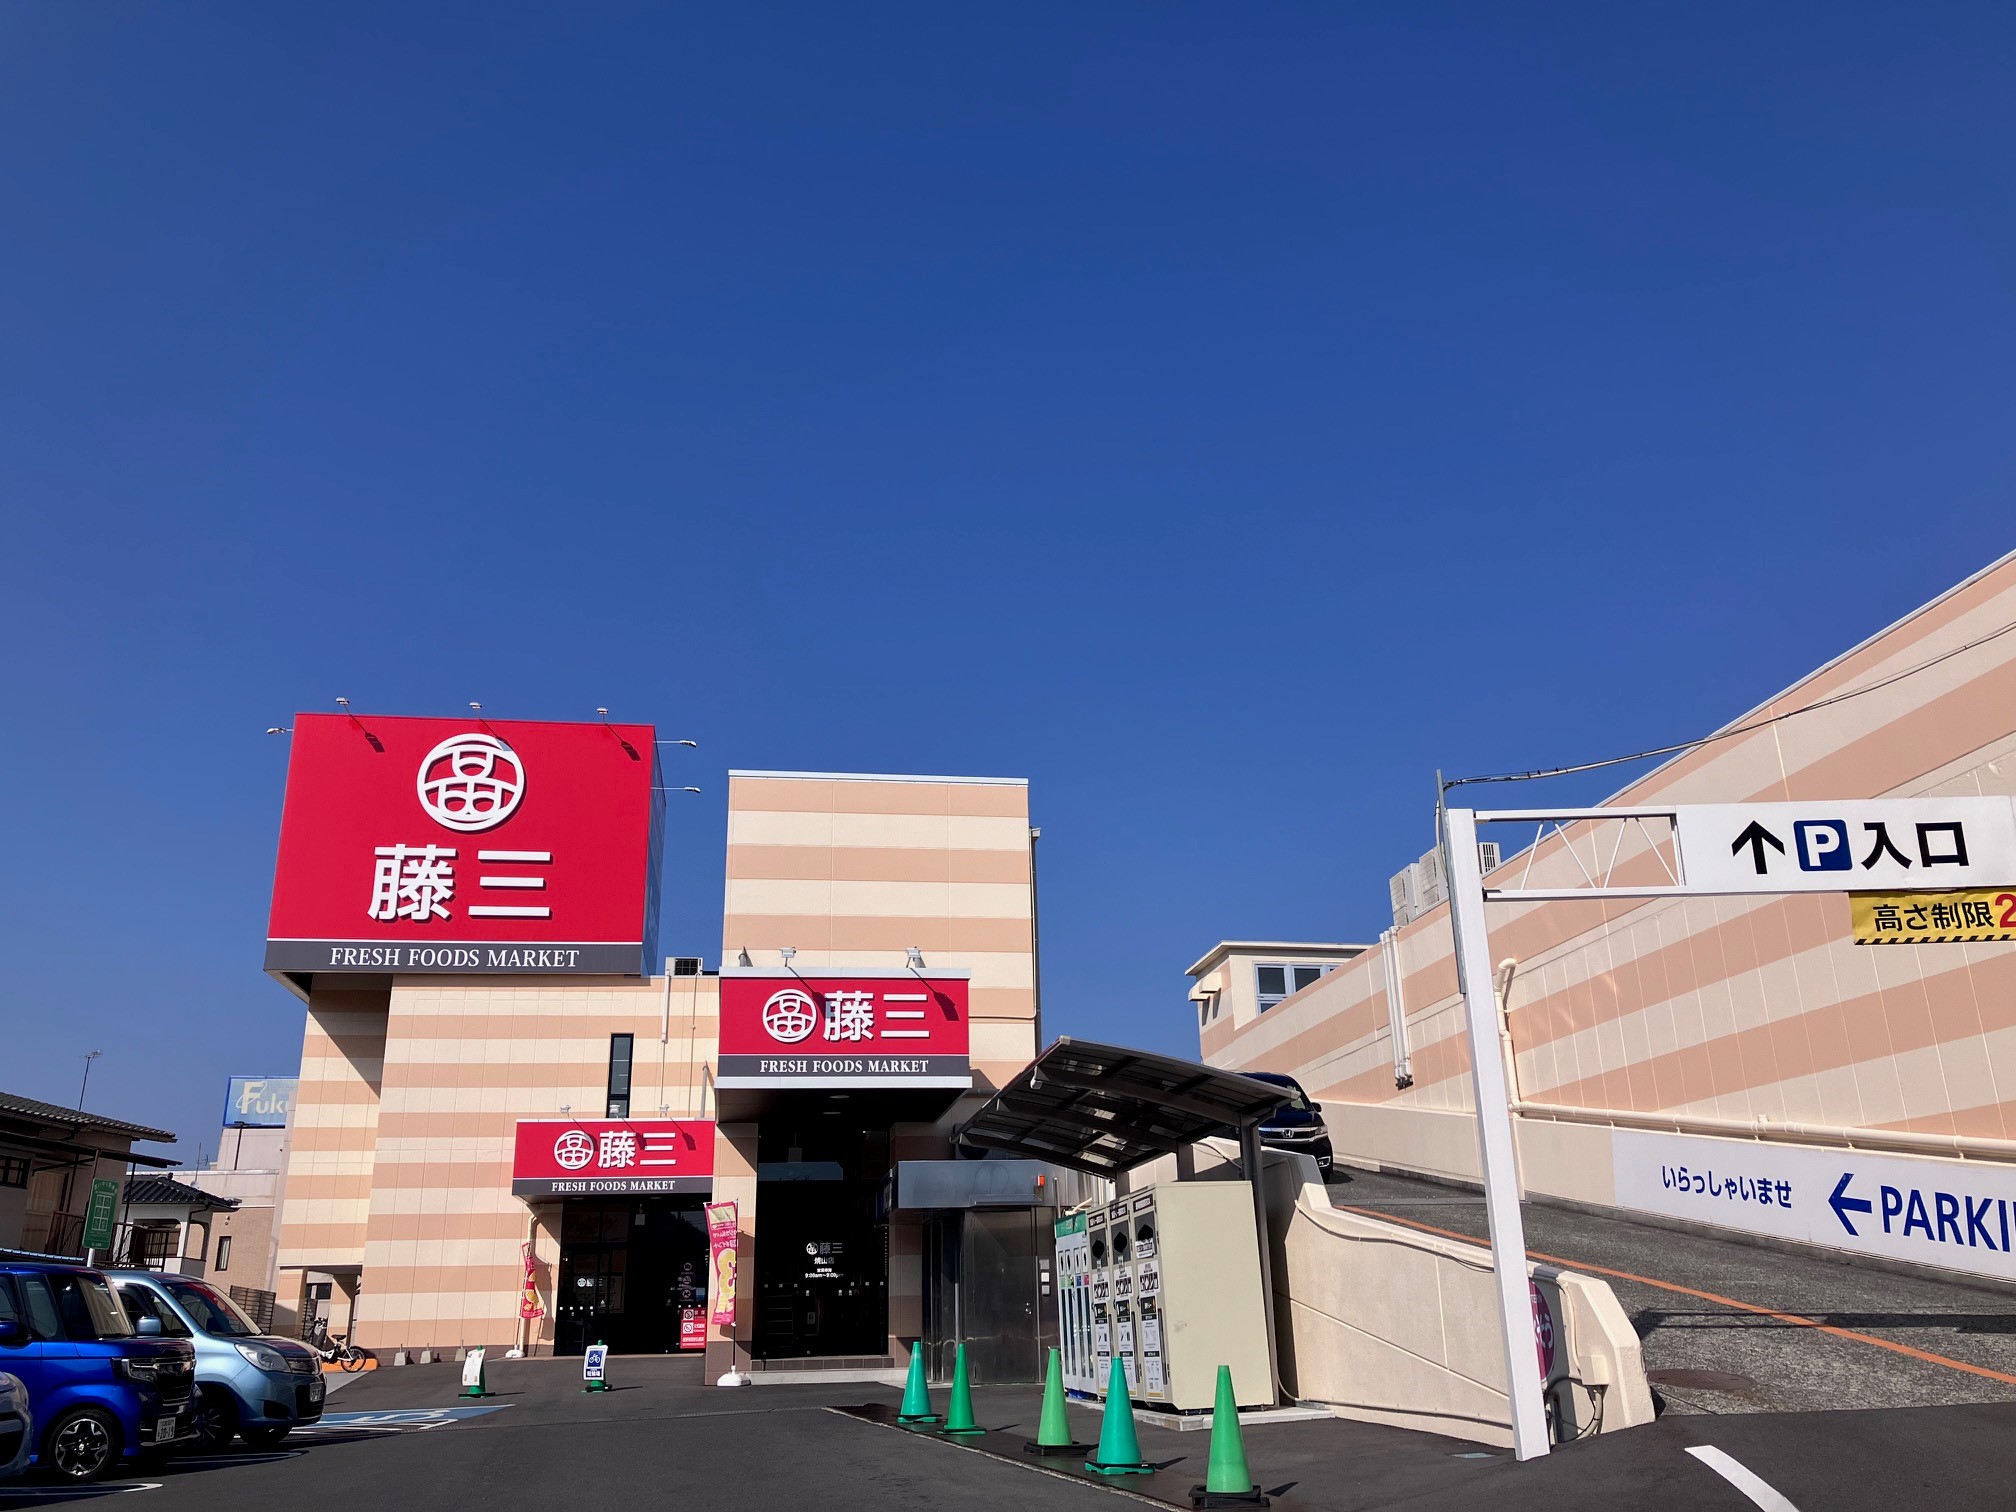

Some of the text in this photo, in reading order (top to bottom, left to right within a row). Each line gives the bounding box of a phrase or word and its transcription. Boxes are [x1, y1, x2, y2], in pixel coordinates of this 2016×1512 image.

[1803, 821, 1970, 870] P 入口
[367, 843, 551, 920] 藤三
[1872, 901, 1995, 932] 高さ制限
[329, 947, 580, 968] FRESH FOODS MARKET
[823, 990, 930, 1041] 藤三
[760, 1060, 929, 1073] FRESH FOODS MARKET
[597, 1131, 676, 1168] 藤三
[551, 1180, 676, 1192] FRESH FOODS MARKET
[1662, 1166, 1792, 1208] いらっしゃいませ
[1880, 1185, 2016, 1253] PARKI
[819, 1242, 843, 1254] 藤三
